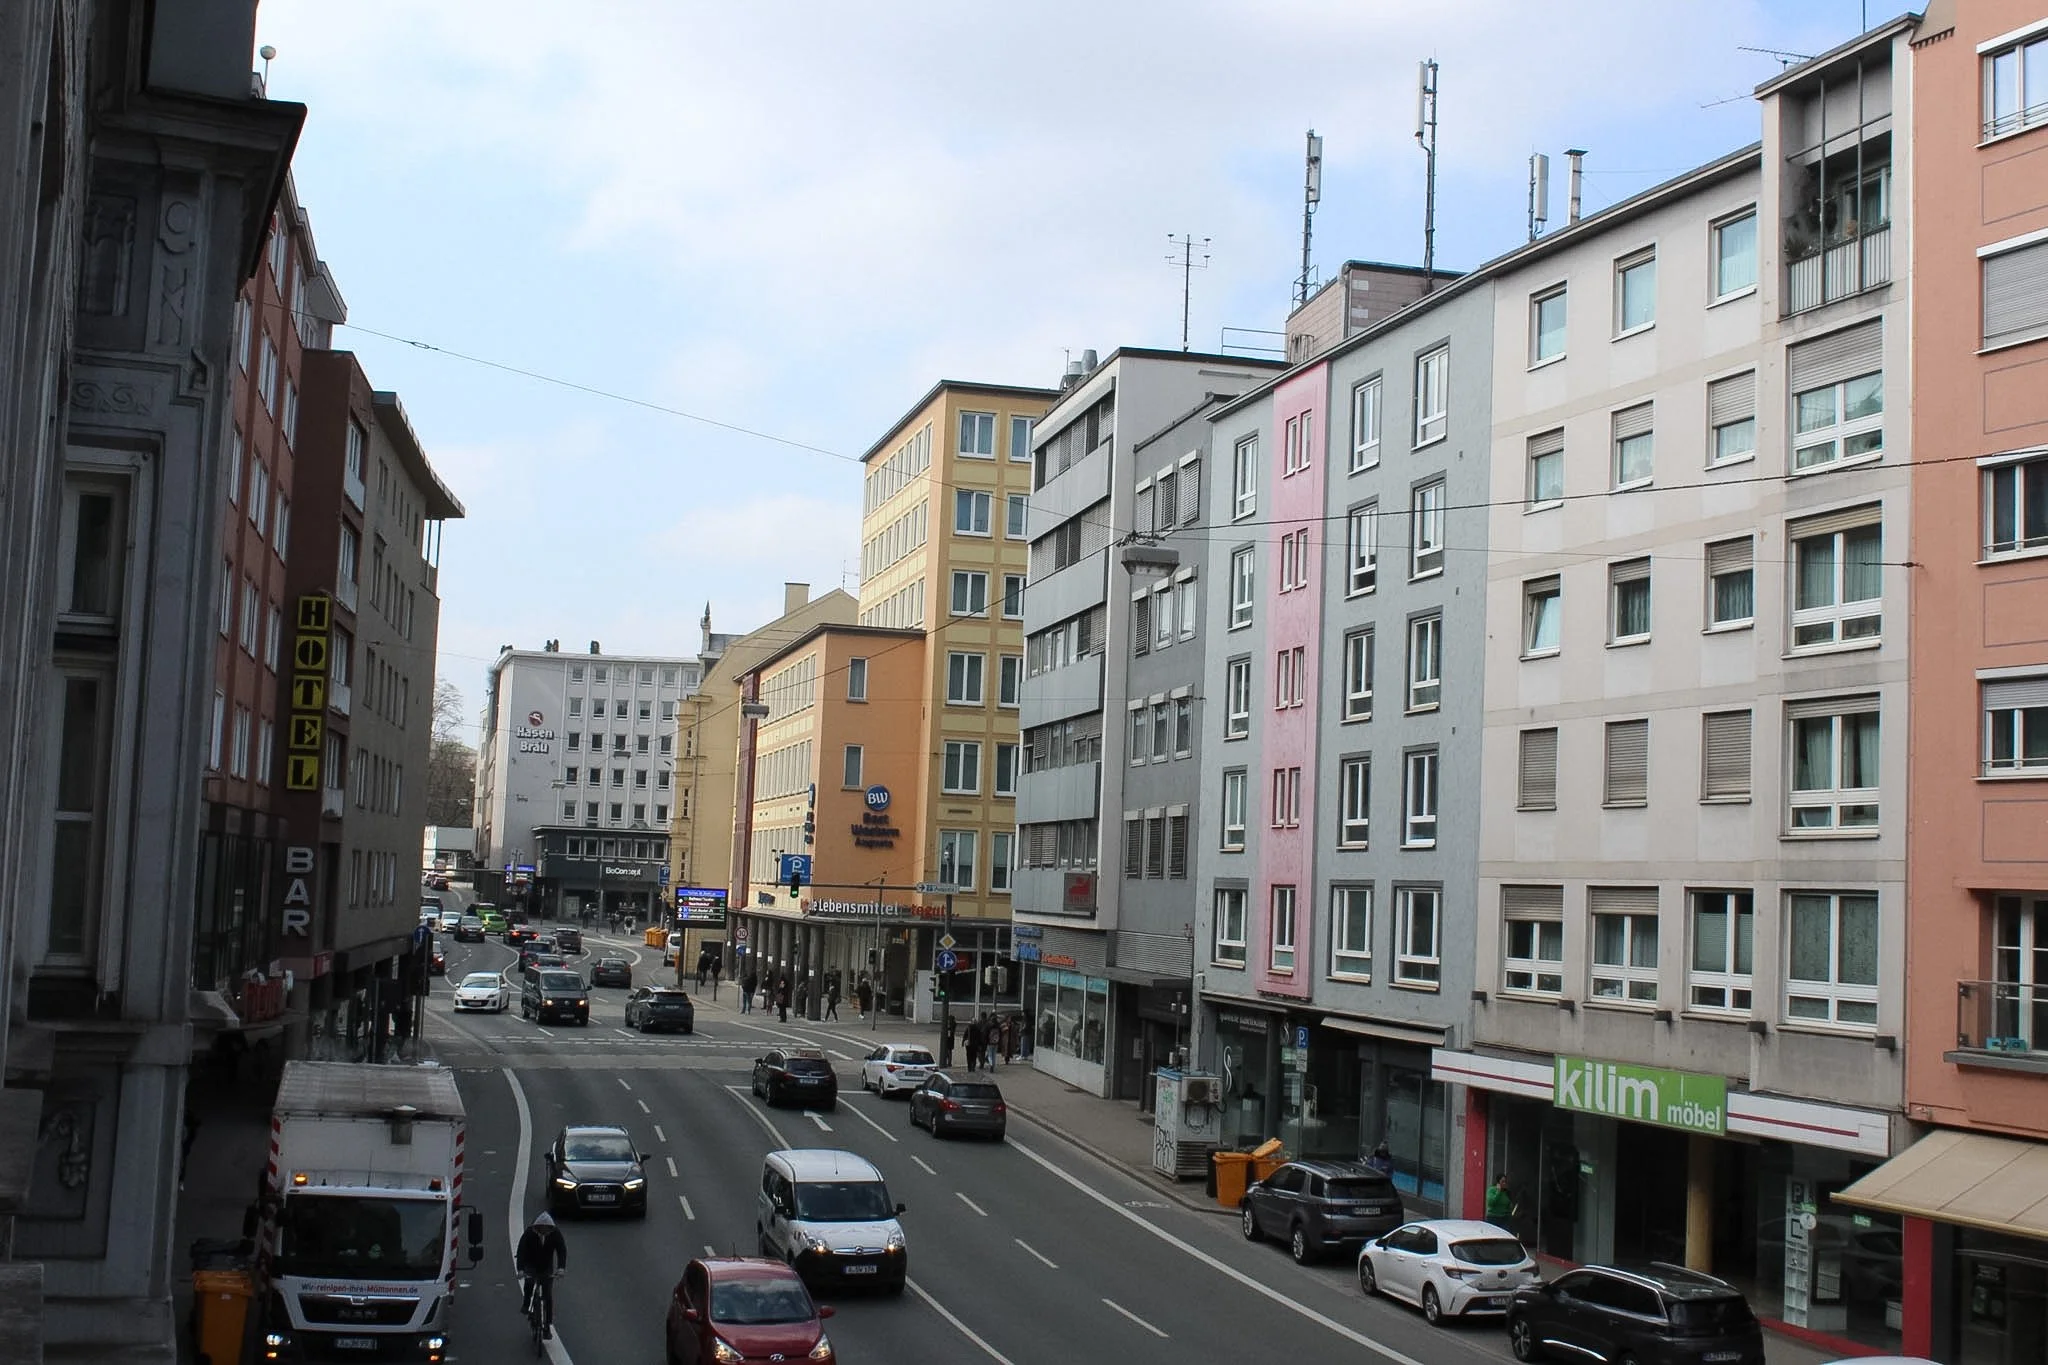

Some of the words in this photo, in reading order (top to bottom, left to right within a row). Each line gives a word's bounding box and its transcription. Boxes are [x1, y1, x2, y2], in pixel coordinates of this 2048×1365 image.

[289, 597, 329, 789] HOTEL
[516, 726, 554, 740] Hasen
[520, 740, 549, 754] Bräu
[867, 792, 889, 805] BW
[281, 846, 314, 937] BAR
[819, 898, 899, 916] Lebensmittel
[1558, 1058, 1659, 1121] kilim
[1667, 1101, 1721, 1131] möbel
